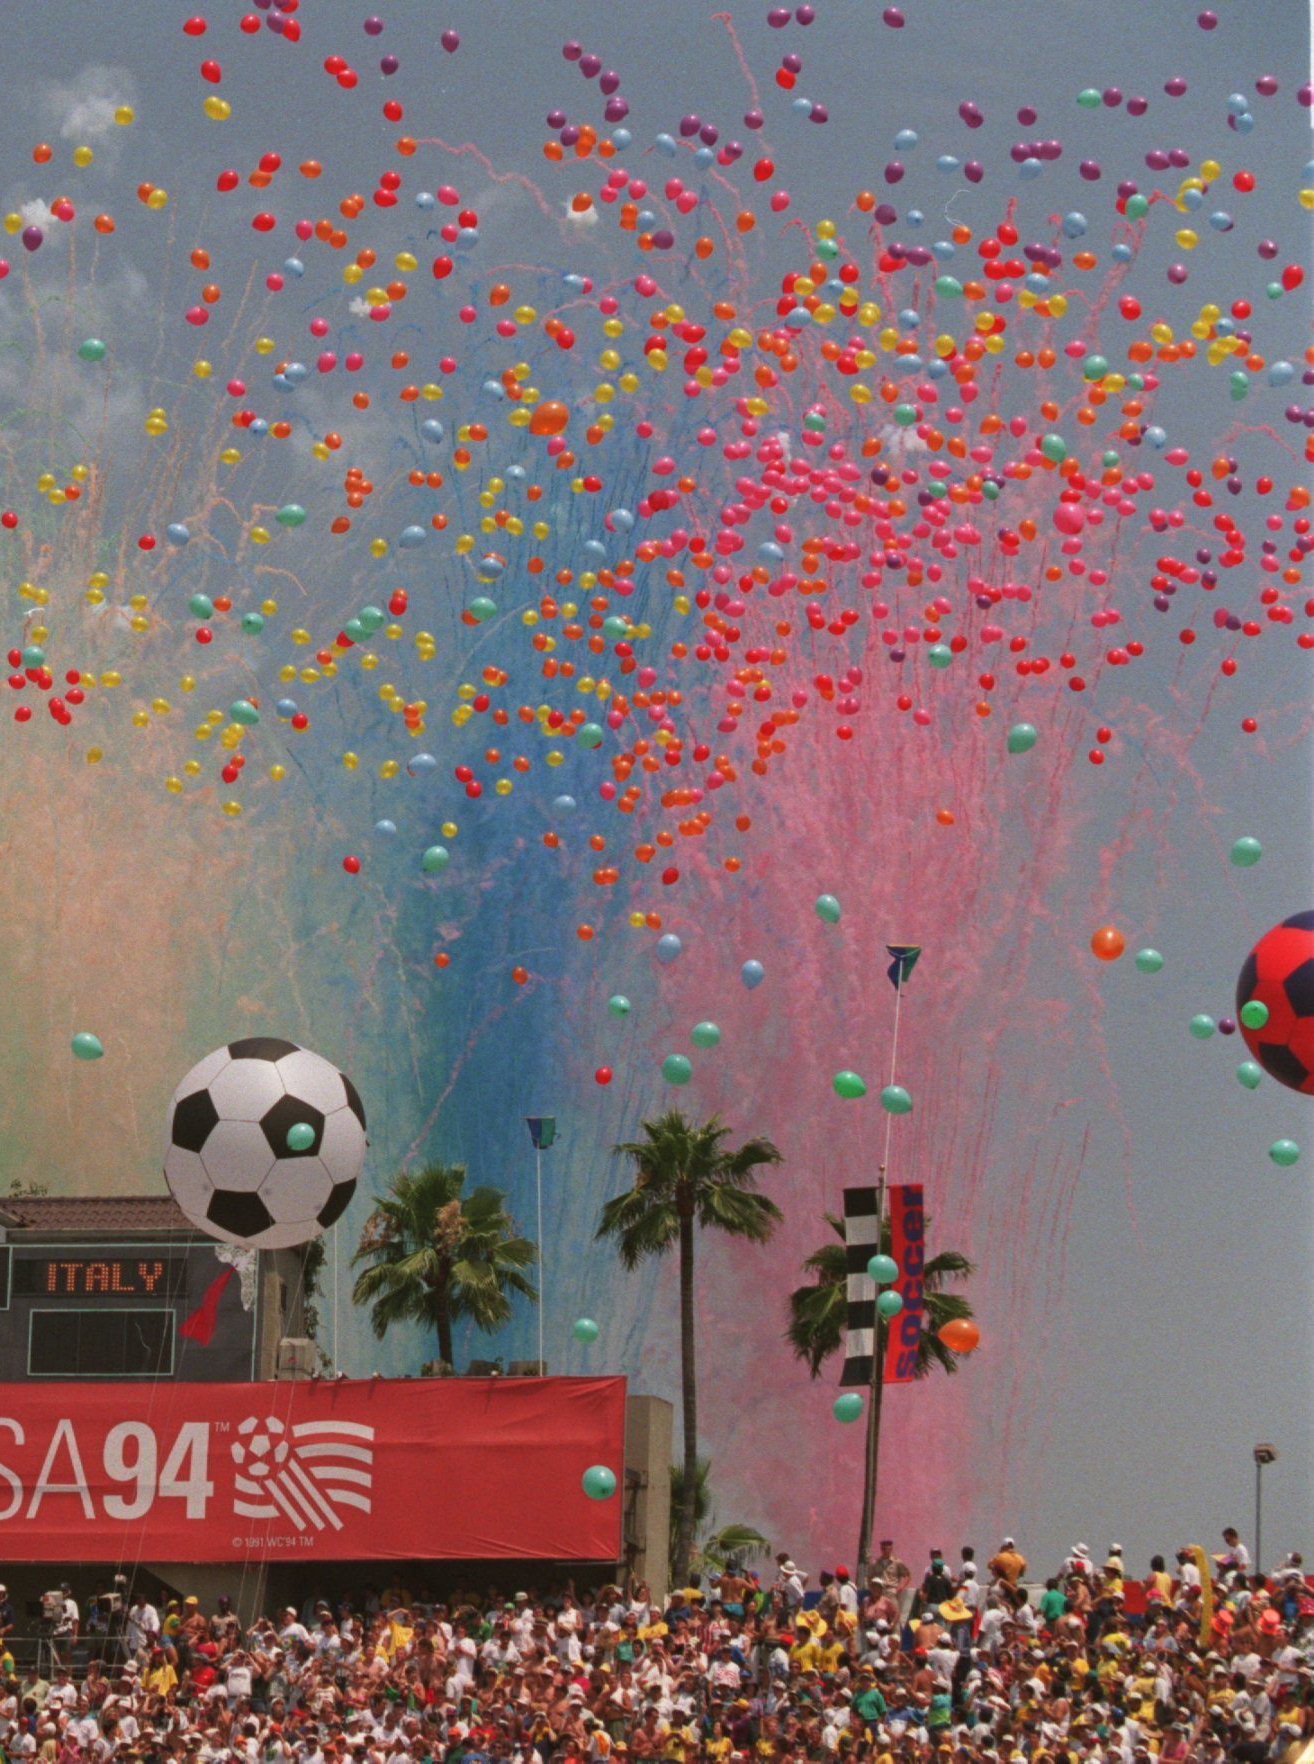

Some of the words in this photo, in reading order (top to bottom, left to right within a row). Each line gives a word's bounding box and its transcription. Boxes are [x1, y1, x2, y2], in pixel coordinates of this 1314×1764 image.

[46, 1261, 163, 1292] ITALY
[896, 1184, 925, 1379] soccer
[245, 1537, 264, 1547] 1991
